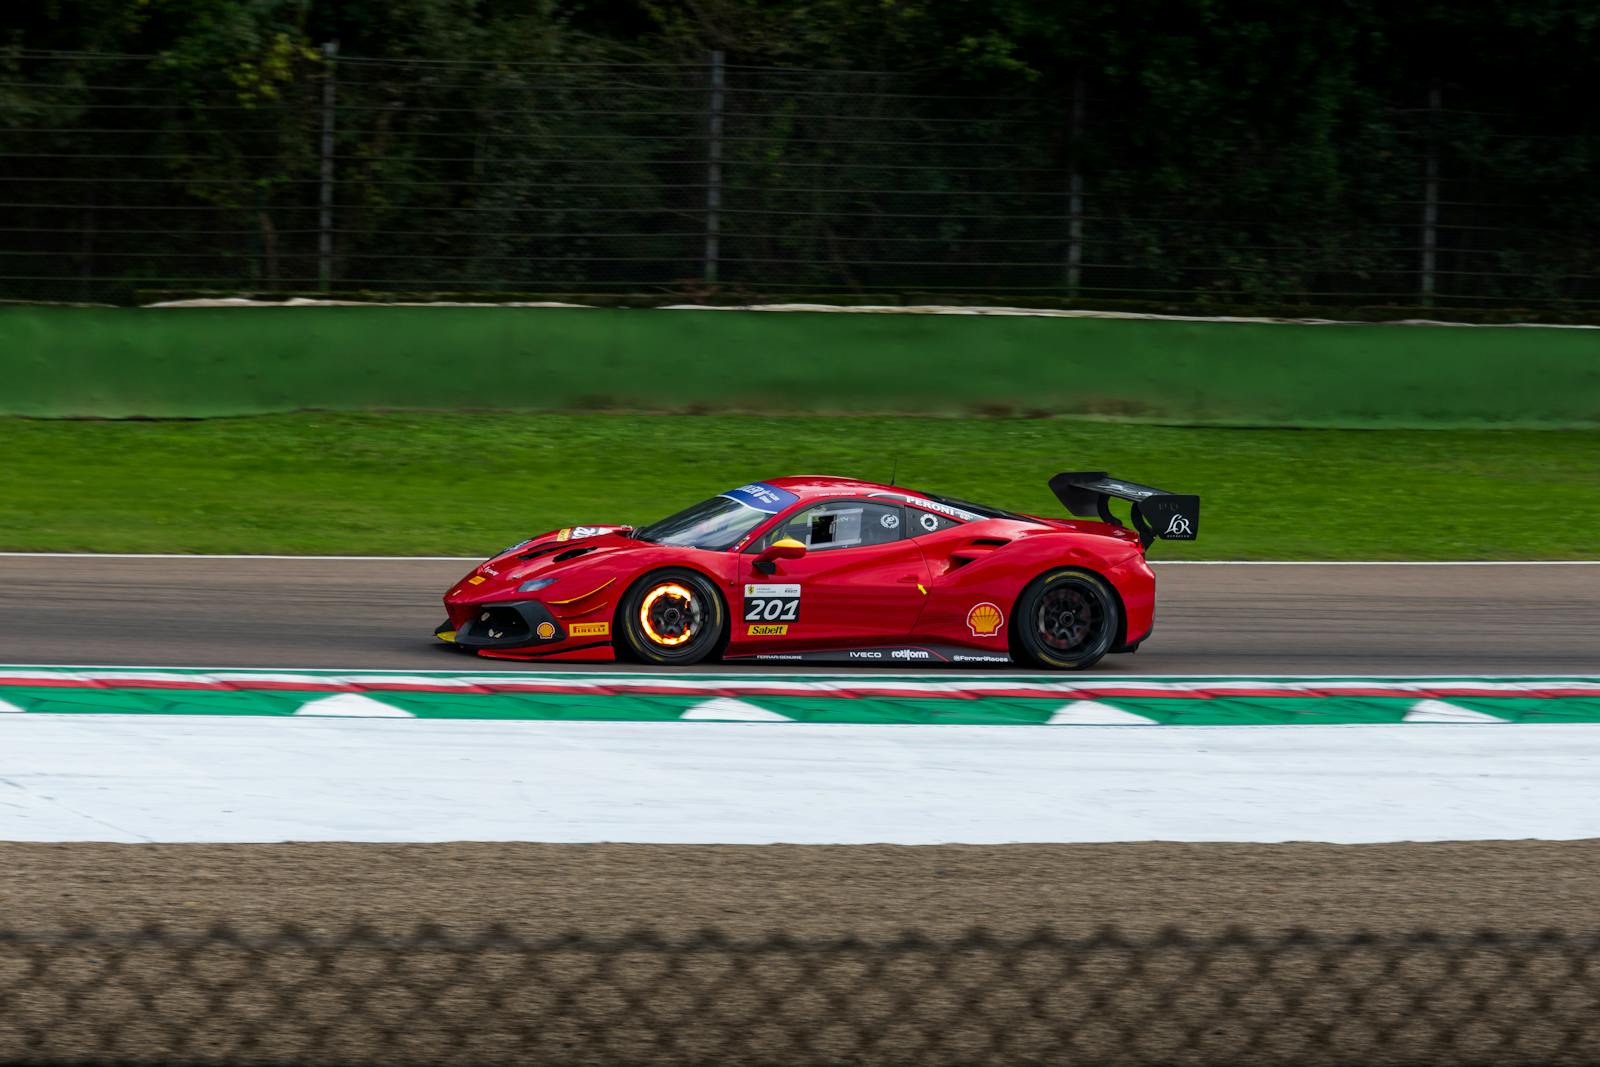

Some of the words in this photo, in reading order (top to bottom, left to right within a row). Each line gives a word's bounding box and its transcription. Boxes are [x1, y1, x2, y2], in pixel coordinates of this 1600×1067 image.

[906, 496, 955, 516] PERONI
[745, 599, 800, 621] 201
[891, 649, 929, 661] rotiform
